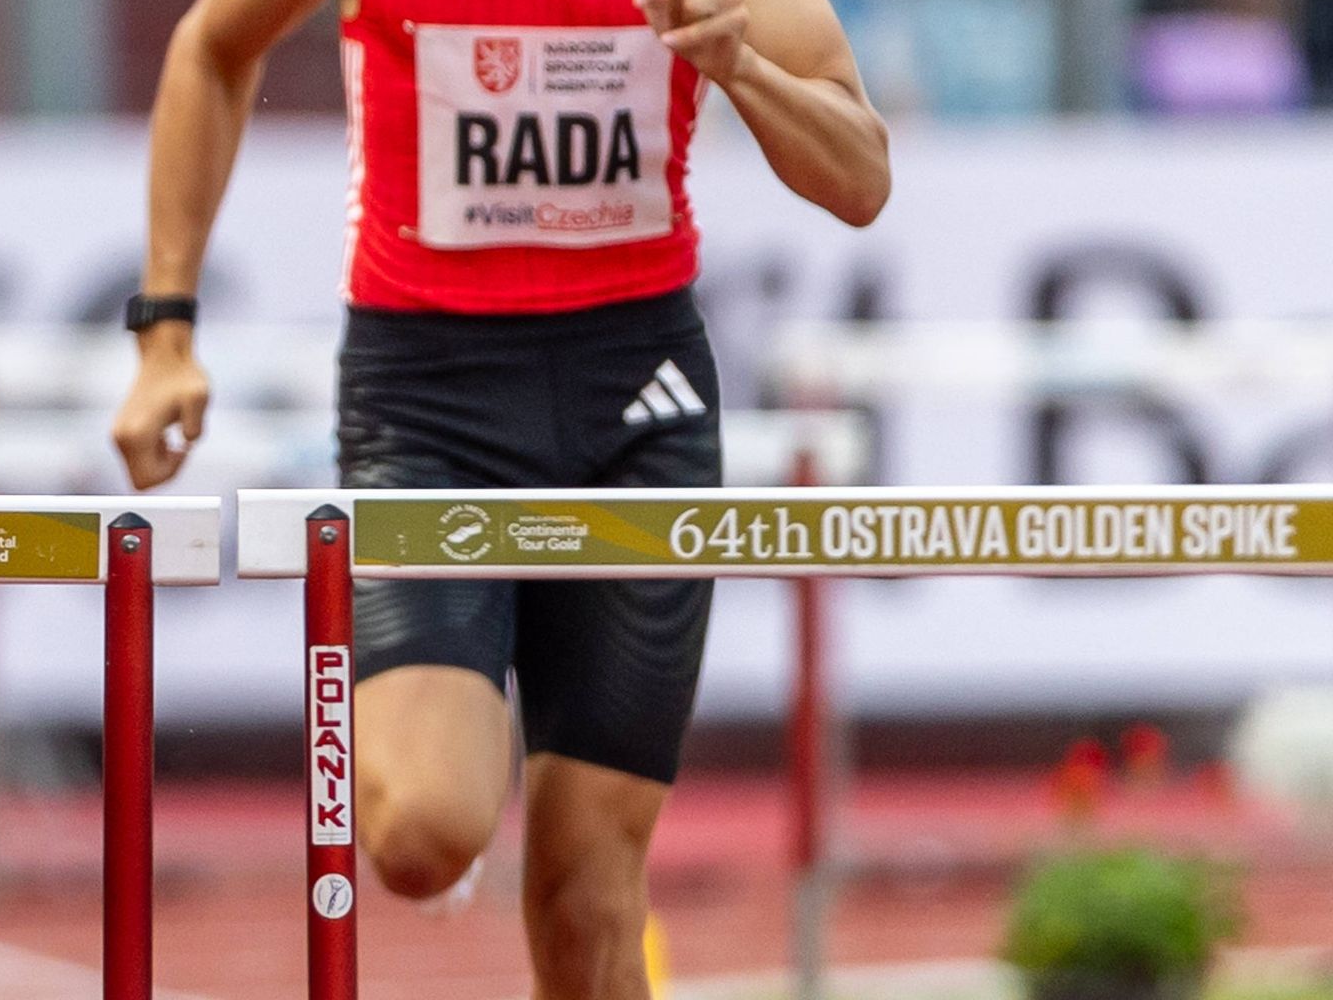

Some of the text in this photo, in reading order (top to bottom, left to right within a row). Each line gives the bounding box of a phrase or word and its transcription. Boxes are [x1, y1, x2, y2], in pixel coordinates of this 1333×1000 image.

[456, 108, 640, 186] RADA
[507, 523, 589, 537] Continental
[515, 537, 582, 550] Tour Gold
[669, 503, 1298, 559] 64th OSTRAVA GOLDEN SPIKE
[314, 651, 347, 828] POLANIK
